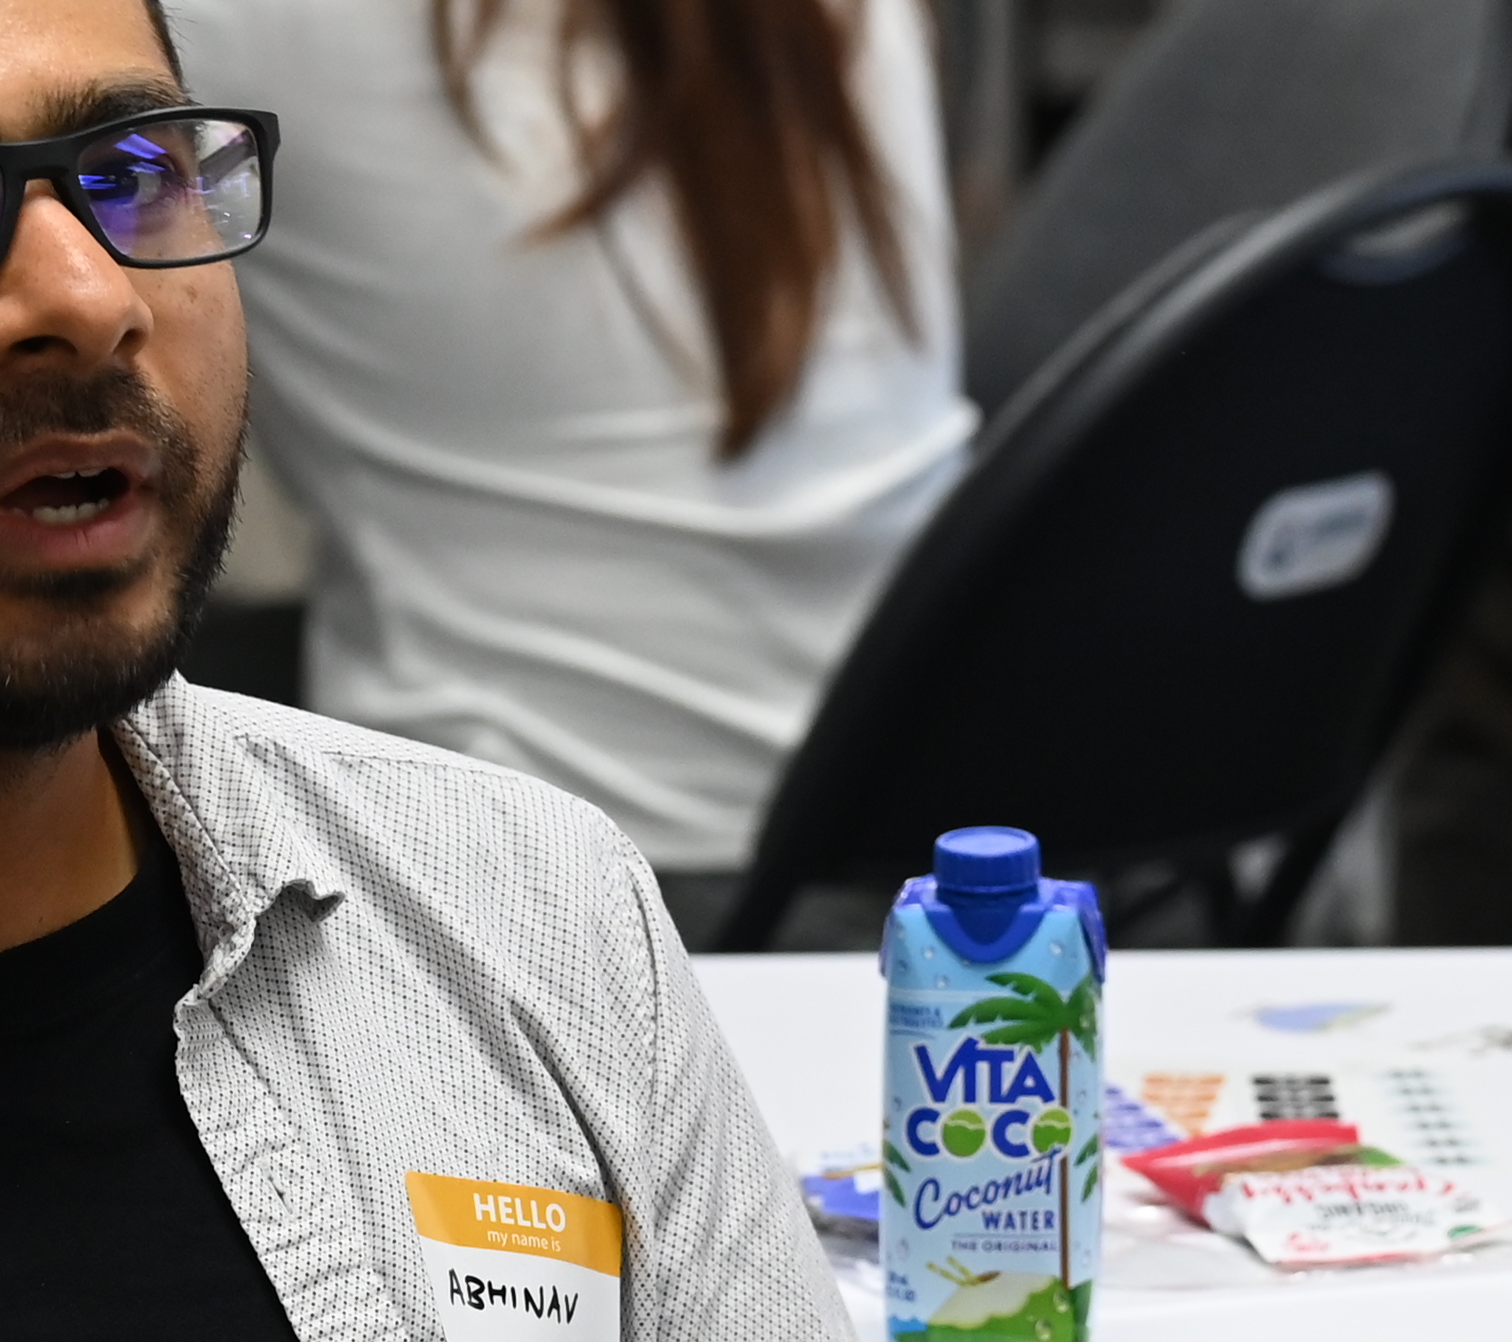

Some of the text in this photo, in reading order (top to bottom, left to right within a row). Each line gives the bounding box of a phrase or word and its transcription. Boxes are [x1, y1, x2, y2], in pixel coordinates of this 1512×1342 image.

[914, 1037, 1056, 1105] VITA
[906, 1107, 1073, 1158] COCO
[473, 1192, 567, 1232] HELLO
[914, 1147, 1061, 1230] Coconut
[487, 1229, 561, 1252] my name is
[982, 1210, 1055, 1231] WATER
[448, 1267, 579, 1325] ABHINAV
